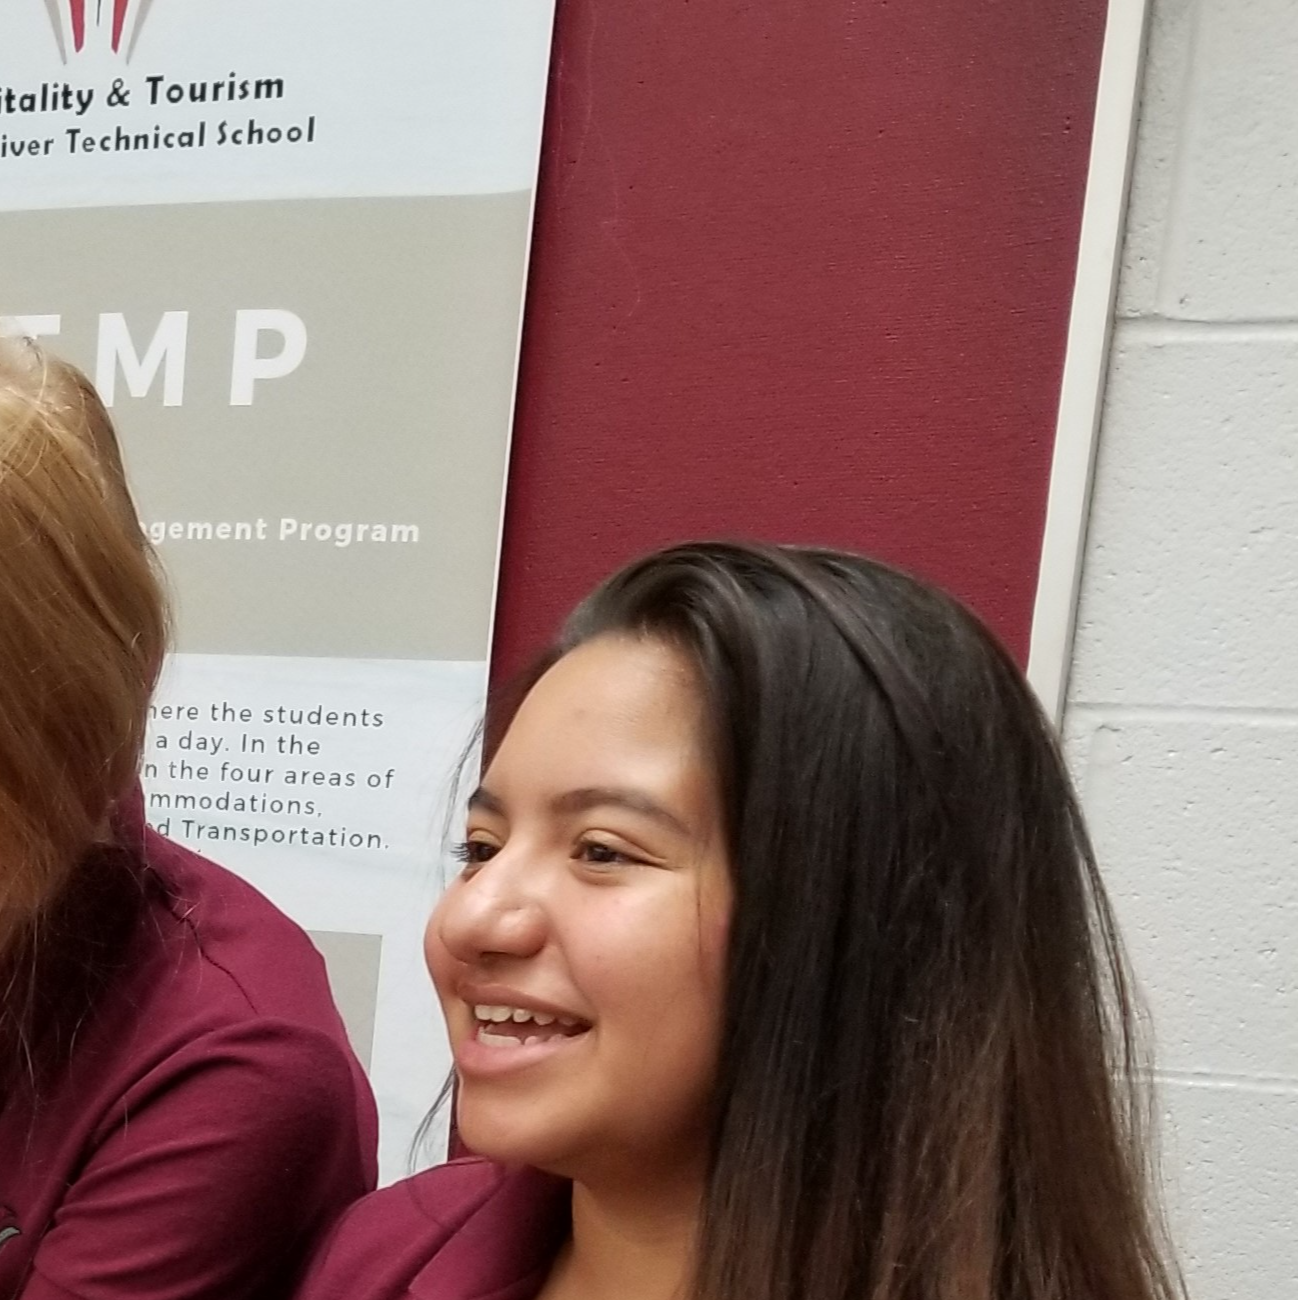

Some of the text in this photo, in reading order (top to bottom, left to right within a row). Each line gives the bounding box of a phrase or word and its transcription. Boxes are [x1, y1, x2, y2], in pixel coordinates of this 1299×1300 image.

[106, 77, 131, 107] &
[146, 71, 284, 104] Tourism
[66, 121, 207, 154] Technical
[217, 116, 315, 147] School
[279, 518, 420, 548] Program
[211, 702, 253, 722] the
[263, 705, 383, 728] students
[156, 730, 321, 755] a day. In the
[168, 760, 209, 780] the
[220, 762, 274, 784] four
[284, 770, 355, 788] areas
[367, 769, 395, 789] of
[182, 819, 391, 849] Transportation.
